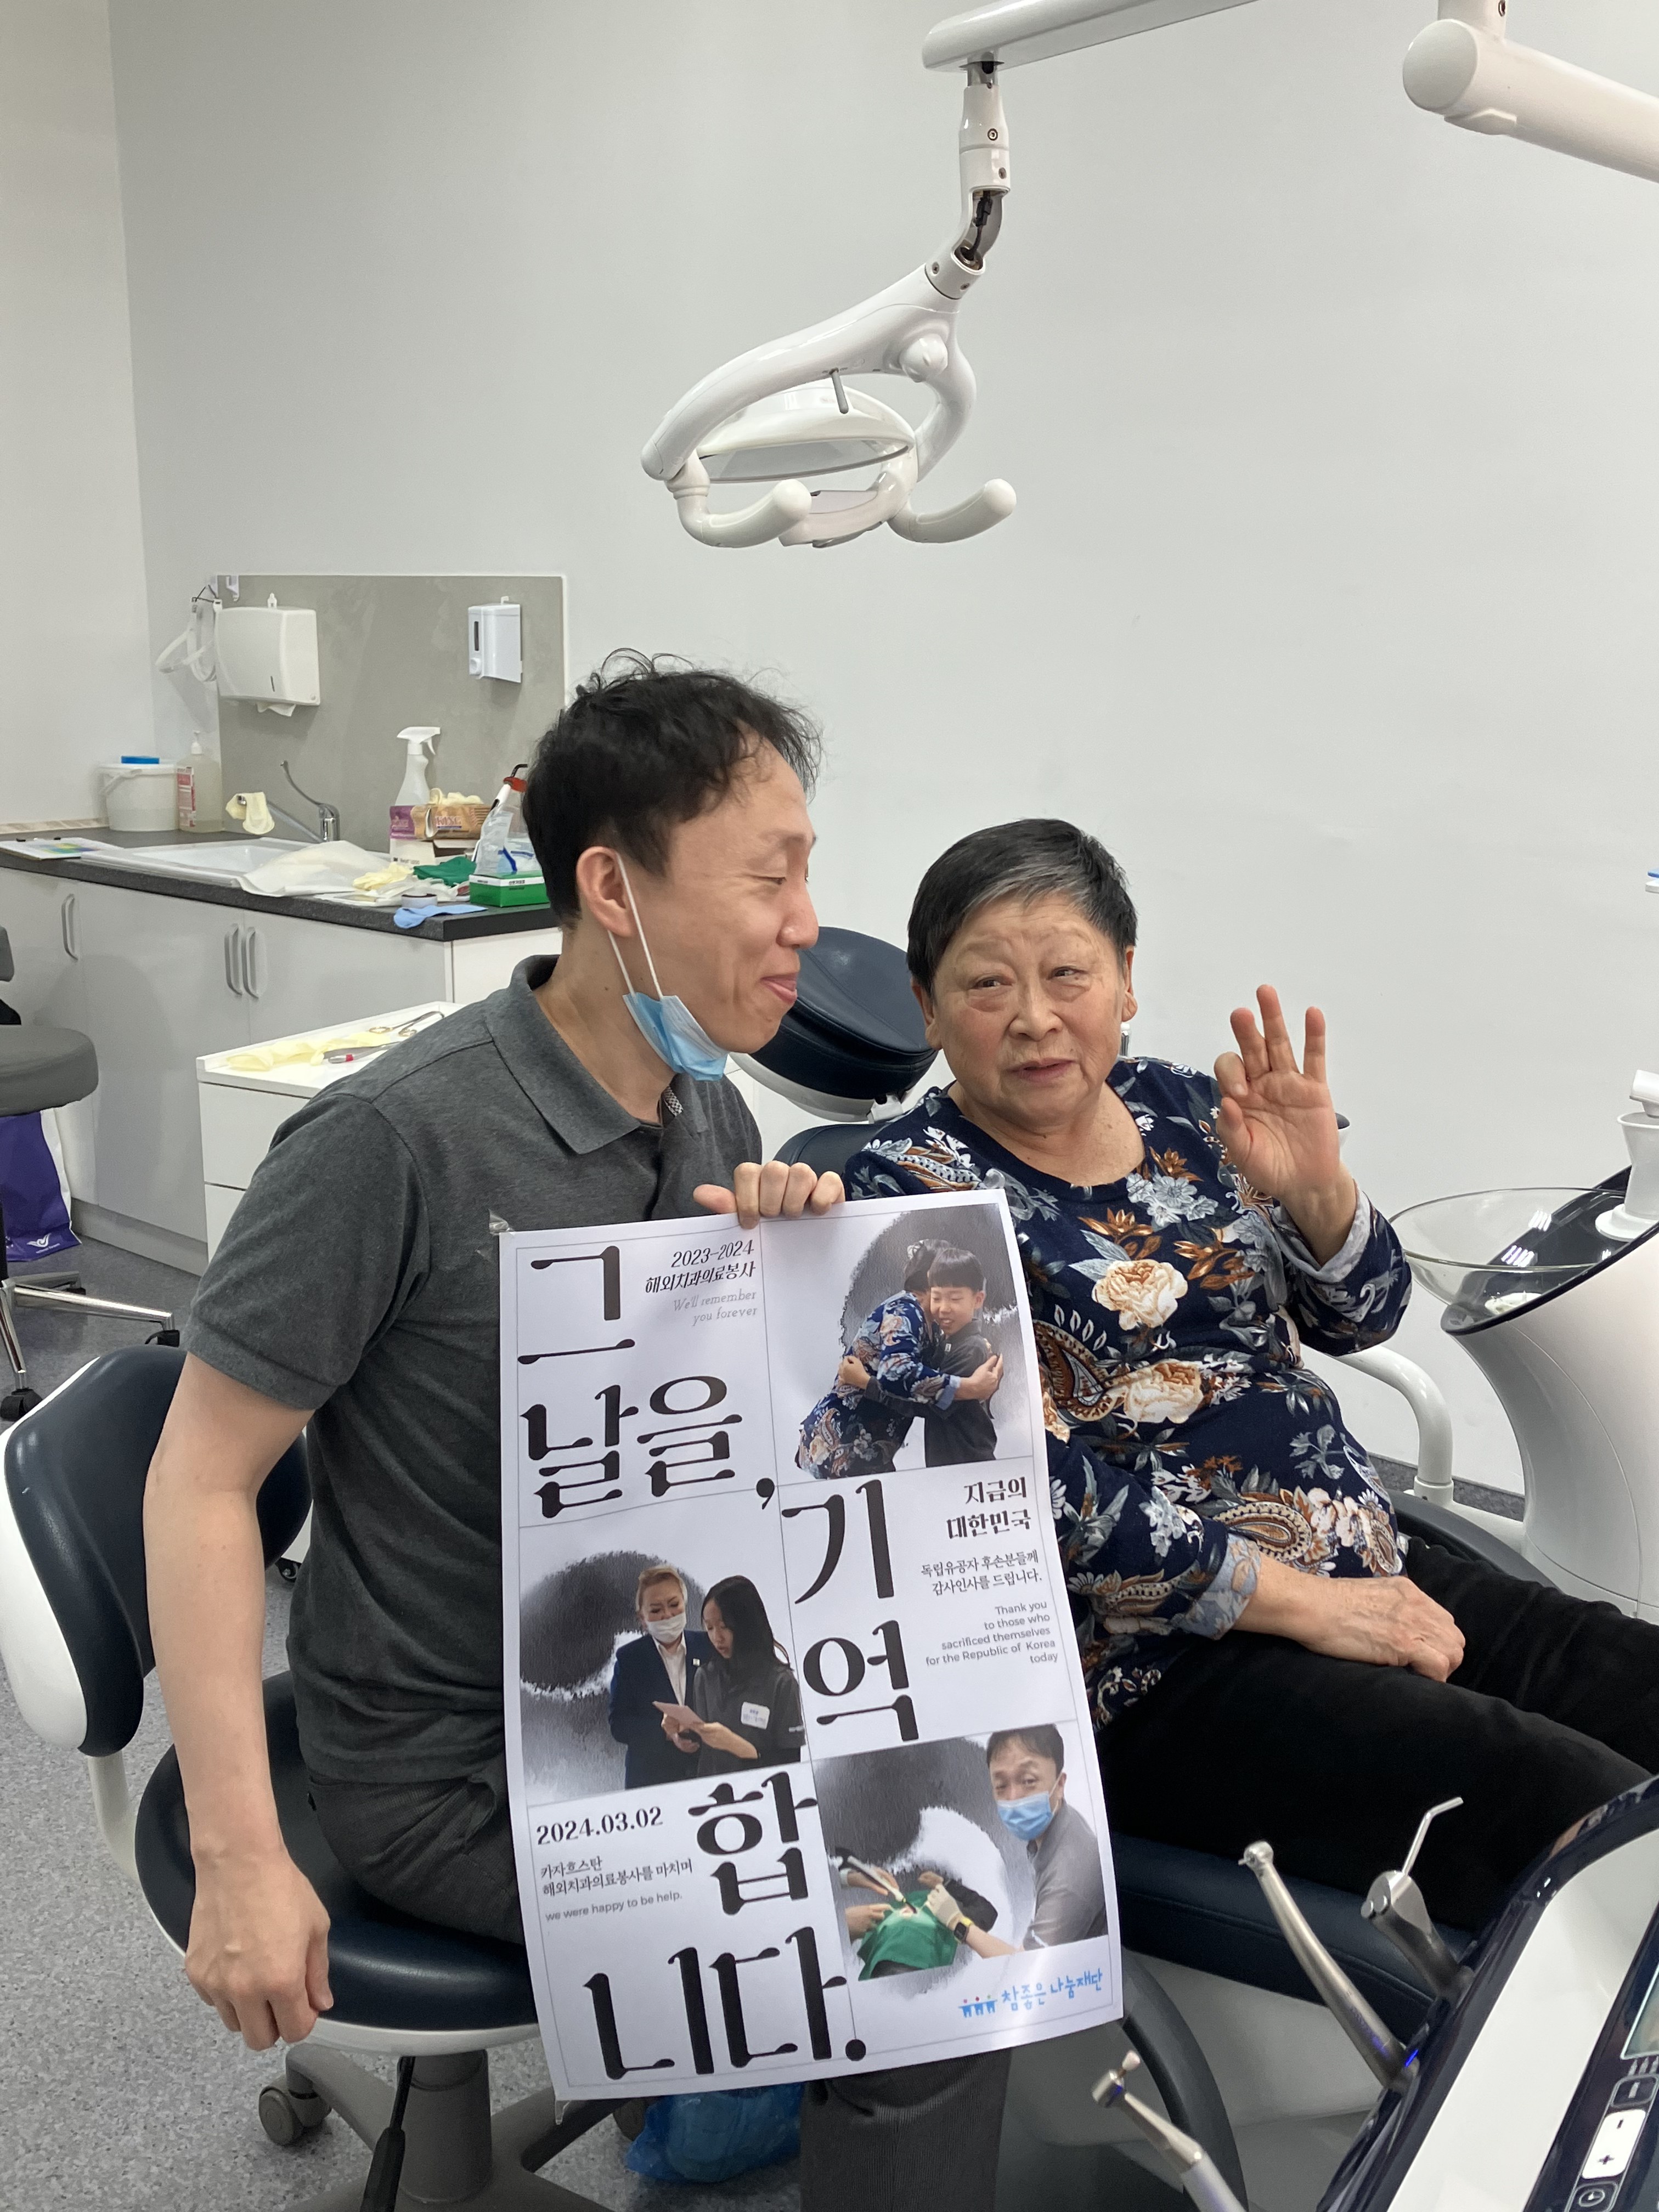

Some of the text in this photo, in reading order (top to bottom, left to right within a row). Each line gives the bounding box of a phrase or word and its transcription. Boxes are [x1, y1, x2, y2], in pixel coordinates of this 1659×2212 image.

[645, 1261, 756, 1293] 해외치과의료봉사
[517, 1245, 635, 1364] 그
[674, 1288, 757, 1312] We'll remember
[692, 1306, 757, 1327] you forever
[964, 1476, 1027, 1504] 지금의
[946, 1509, 1031, 1539] 대한민국
[921, 1549, 1039, 1577] 독립유공자 후손분들께
[933, 1568, 1042, 1596] 감사인사를 드립니다.
[984, 1613, 1050, 1630] to those who
[995, 1601, 1047, 1615] Thank you
[941, 1627, 1051, 1650] sacrificed themselves
[926, 1640, 1056, 1667] for the Republic of Korea
[1030, 1651, 1058, 1663] today
[537, 1806, 663, 1845] 2024.03.02
[540, 1855, 602, 1880] 카자흐스탄
[543, 1858, 693, 1896] 해외치과의료봉사를 마치며
[545, 1891, 682, 1922] we were happy to be help.
